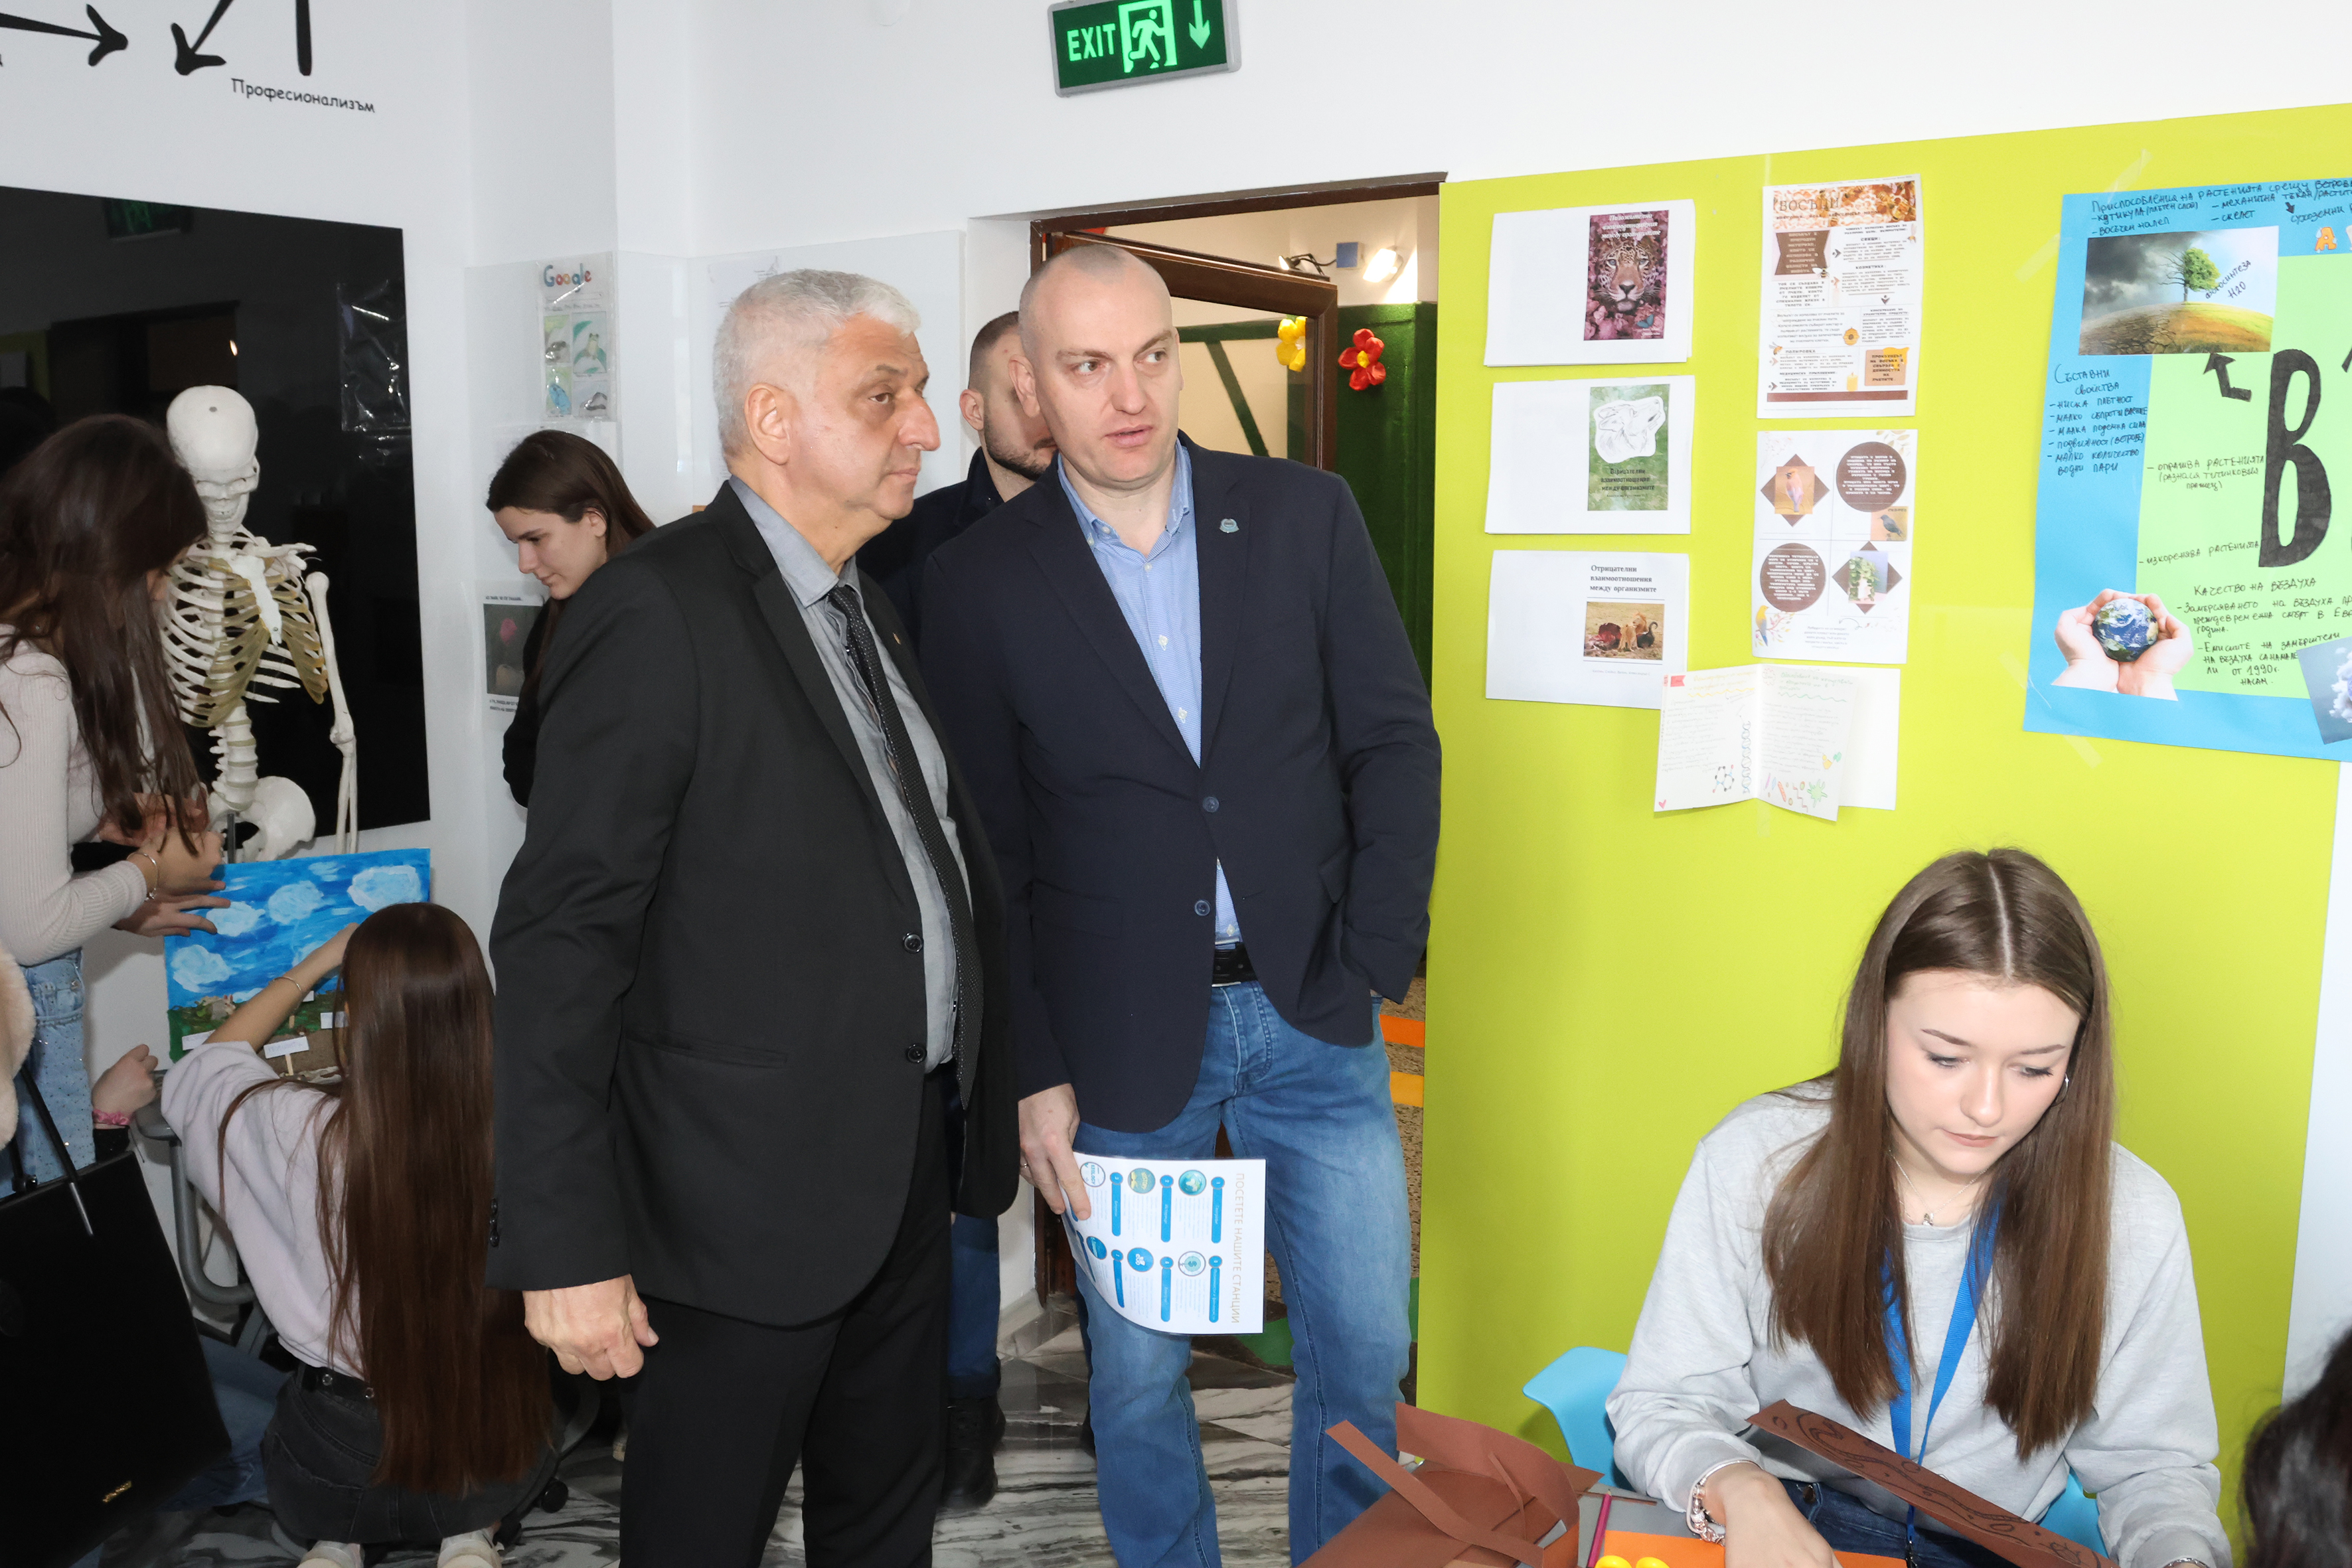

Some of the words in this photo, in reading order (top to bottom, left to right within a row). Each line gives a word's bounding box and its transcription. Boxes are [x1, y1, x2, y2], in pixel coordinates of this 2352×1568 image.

[1067, 23, 1116, 62] EXIT
[231, 78, 375, 113] Професионализъм
[544, 263, 592, 293] Google
[1235, 1173, 1245, 1224] ПОСЕТЕТЕ
[1233, 1227, 1243, 1271] НАШИТЕ
[1230, 1275, 1241, 1323] СТАНЦИИ
